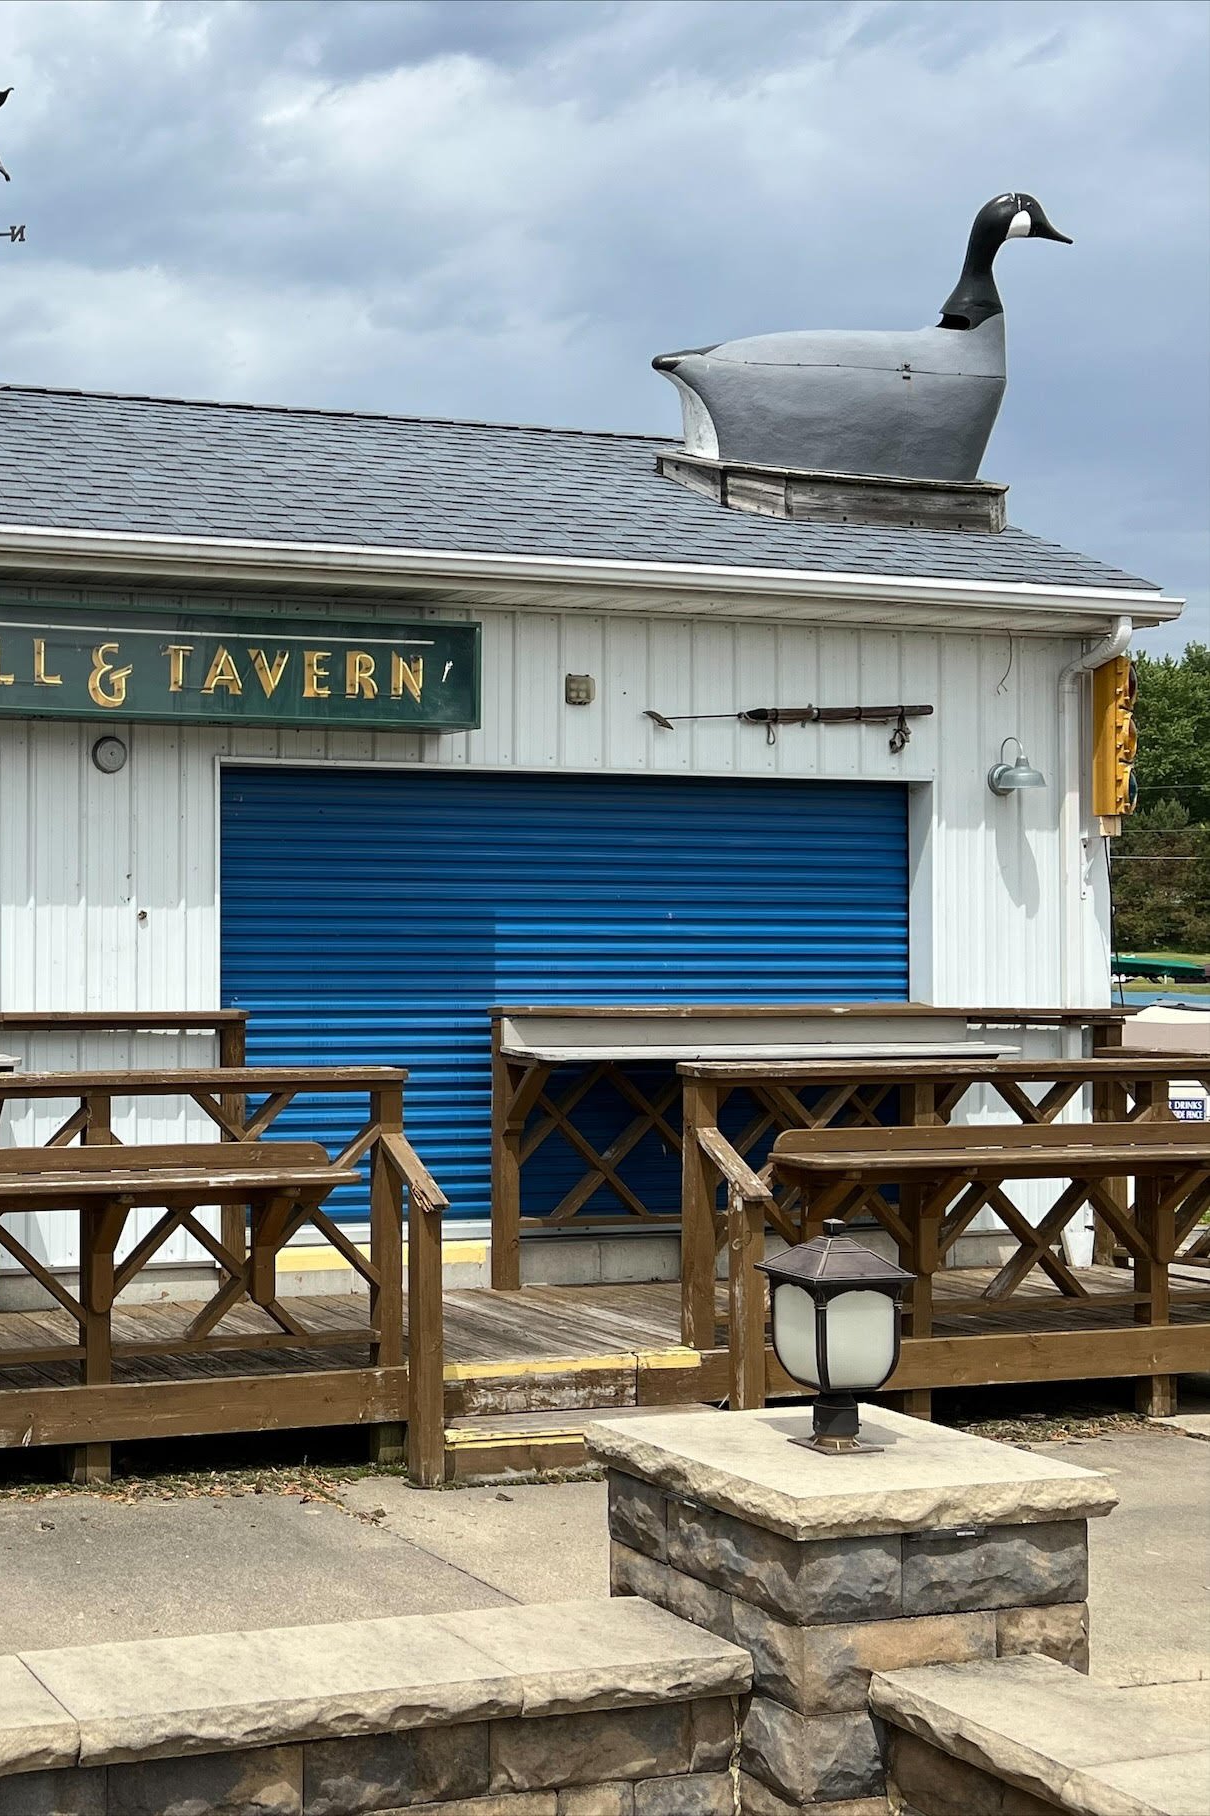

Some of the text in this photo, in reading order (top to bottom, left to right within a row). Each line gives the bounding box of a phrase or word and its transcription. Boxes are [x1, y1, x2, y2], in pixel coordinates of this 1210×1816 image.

[88, 641, 133, 708] &
[161, 643, 424, 703] TAVERN
[1174, 1101, 1202, 1109] DRINKS
[1186, 1110, 1202, 1119] FENCE
